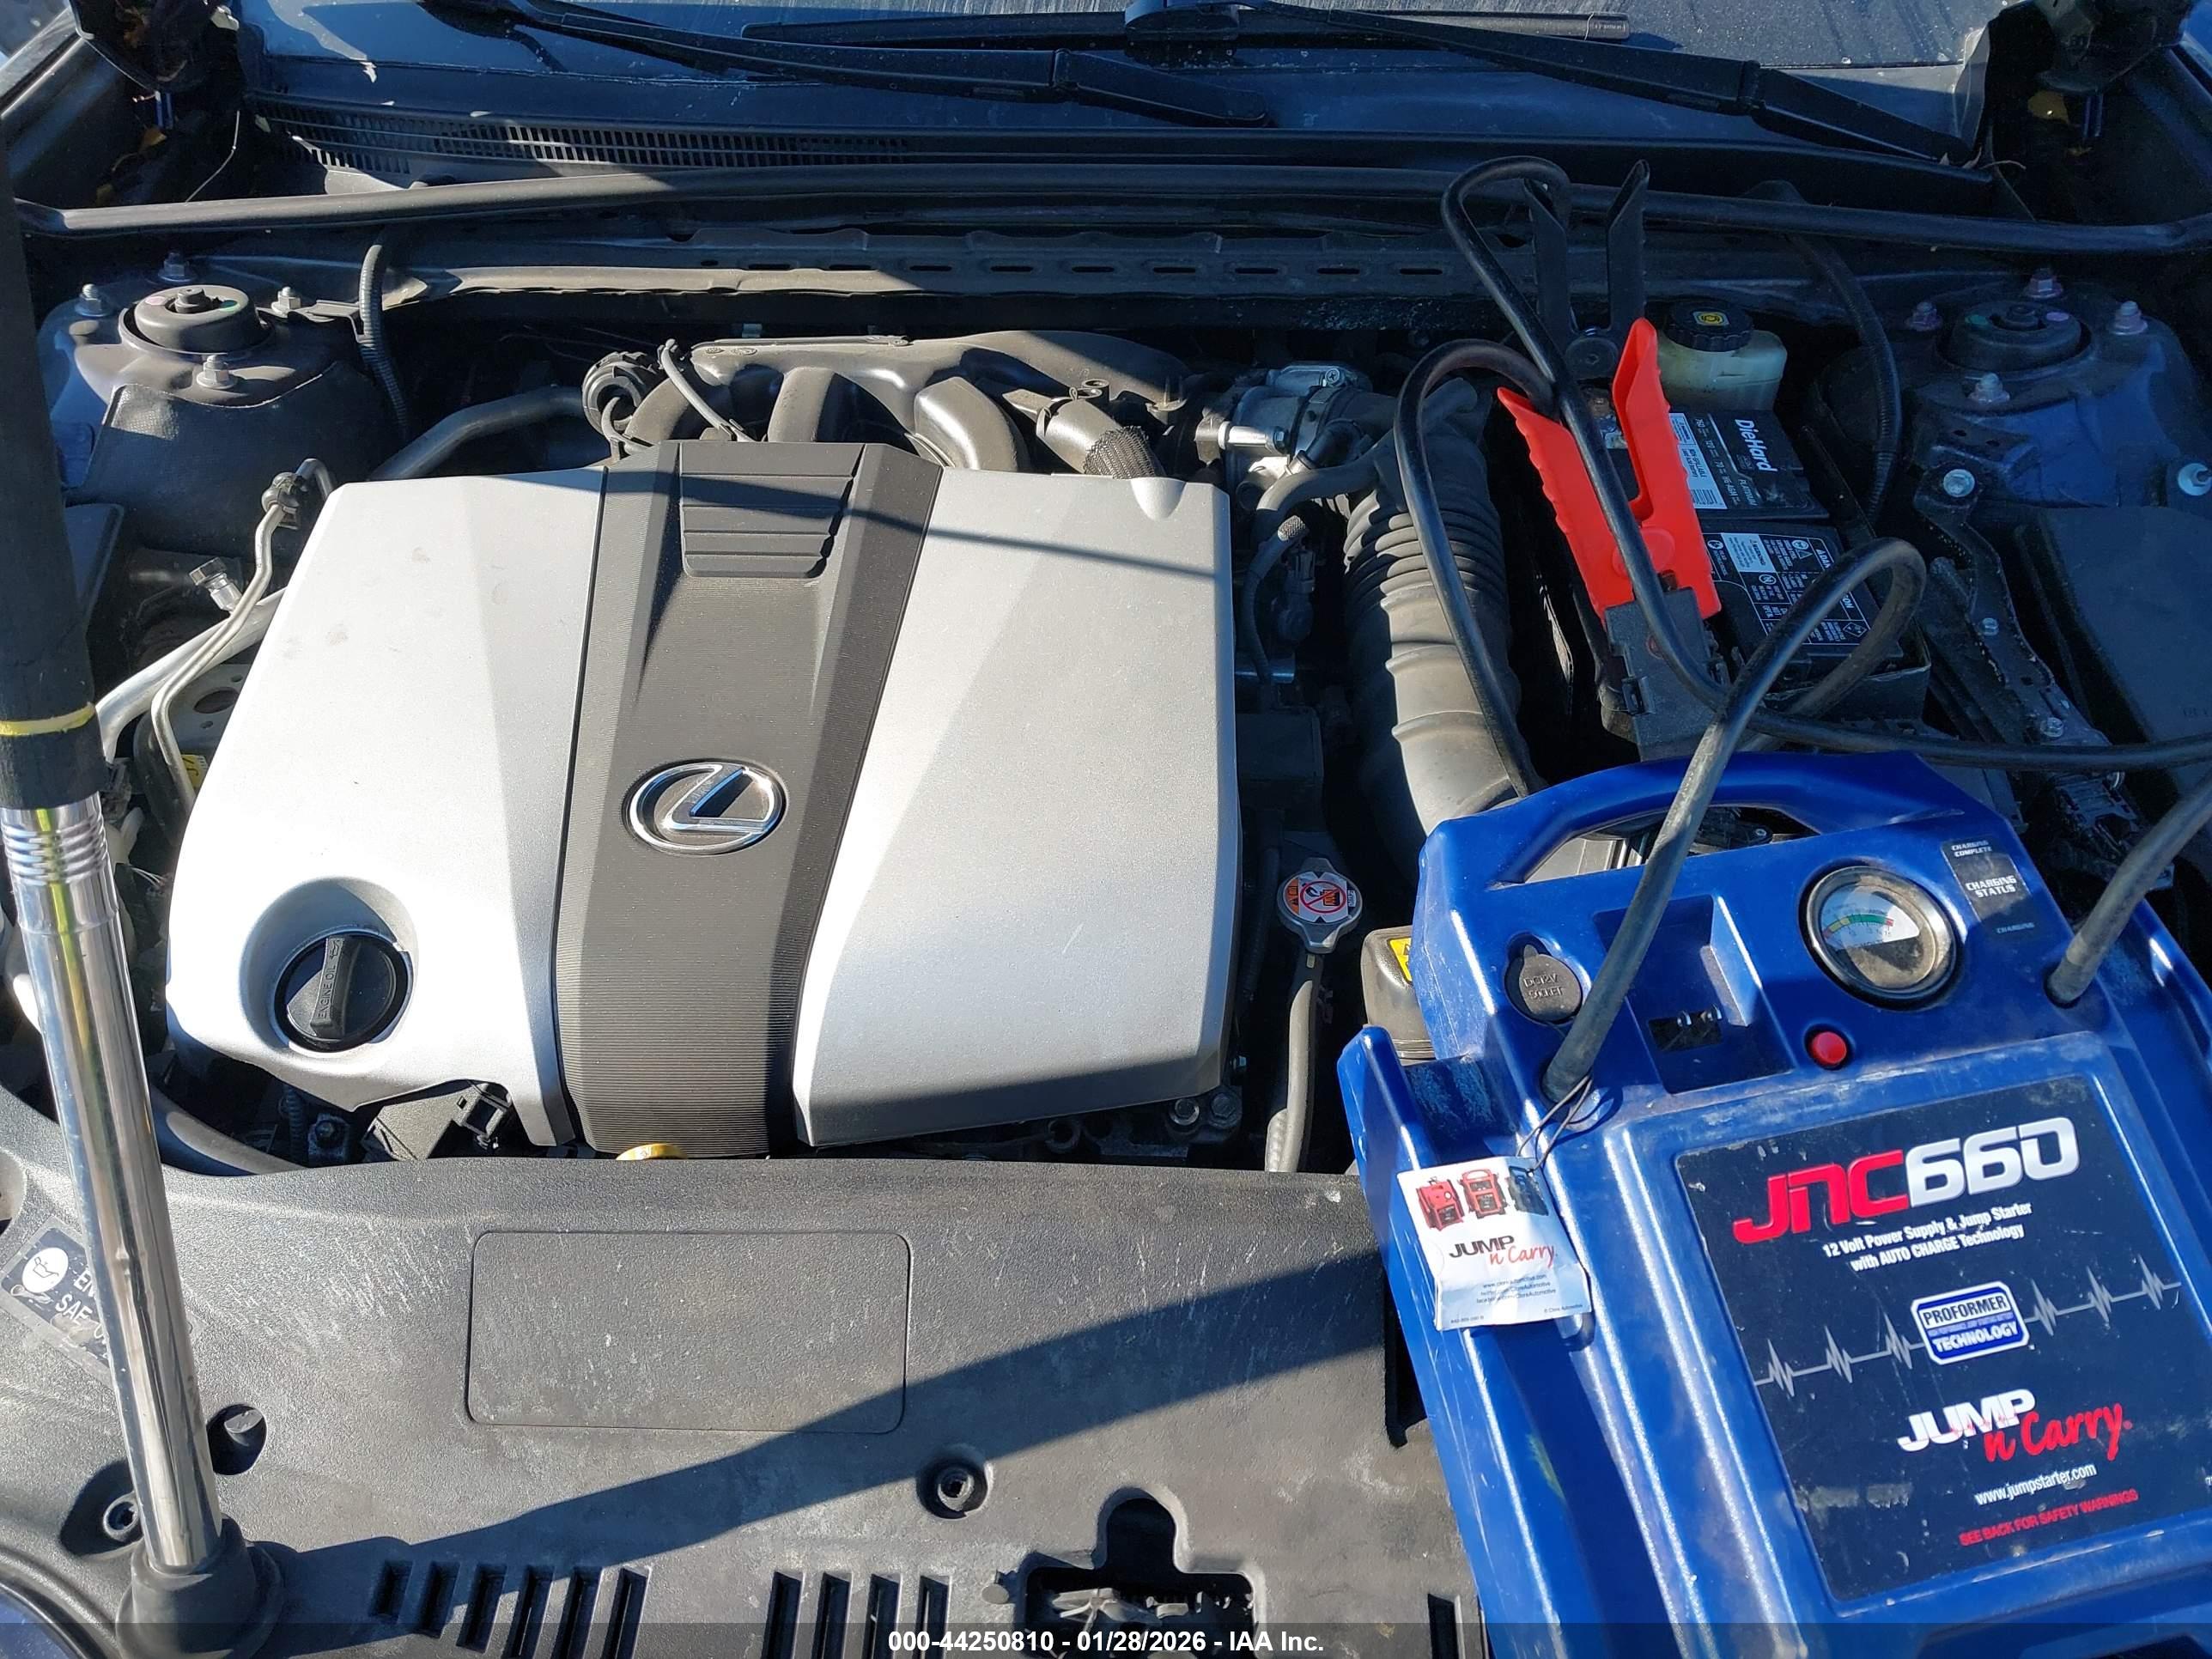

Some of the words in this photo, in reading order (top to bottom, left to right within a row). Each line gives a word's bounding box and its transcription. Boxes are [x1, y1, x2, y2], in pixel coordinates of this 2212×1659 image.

[1734, 419, 1778, 471] DieHard
[1951, 840, 1989, 851] CHARGING
[1954, 846, 1992, 858] COMPLETE
[1965, 875, 2017, 891] CHARGING
[1975, 884, 2016, 898] STATUS
[325, 965, 337, 981] OIL
[319, 983, 332, 1018] ENGINE
[1822, 1243, 1841, 1257] 12
[1839, 1237, 1865, 1255] Volt
[1864, 1230, 1903, 1250] Power
[1904, 1221, 1947, 1240] Supply
[1947, 1217, 1958, 1230] &
[1958, 1211, 1991, 1229] Jump
[1990, 1202, 2033, 1221] Starter
[1449, 1235, 1515, 1258] JUMP
[1850, 1255, 1879, 1271] with
[1880, 1248, 1911, 1266] AUTO
[1911, 1237, 1960, 1258] CHARGE
[1958, 1224, 2025, 1248] Technology
[1923, 1295, 2007, 1325] PROFORMER
[1931, 1321, 2019, 1352] TECHNOLOGY
[1897, 1389, 2036, 1452] JUMP
[1974, 1464, 2097, 1505] www.jumpstarter.com
[1959, 1529, 1983, 1546] SEE
[1983, 1522, 2015, 1540] BACK
[2016, 1516, 2040, 1531] FOR
[2039, 1504, 2080, 1525] SAFETY
[2080, 1488, 2139, 1515] WARNINGS
